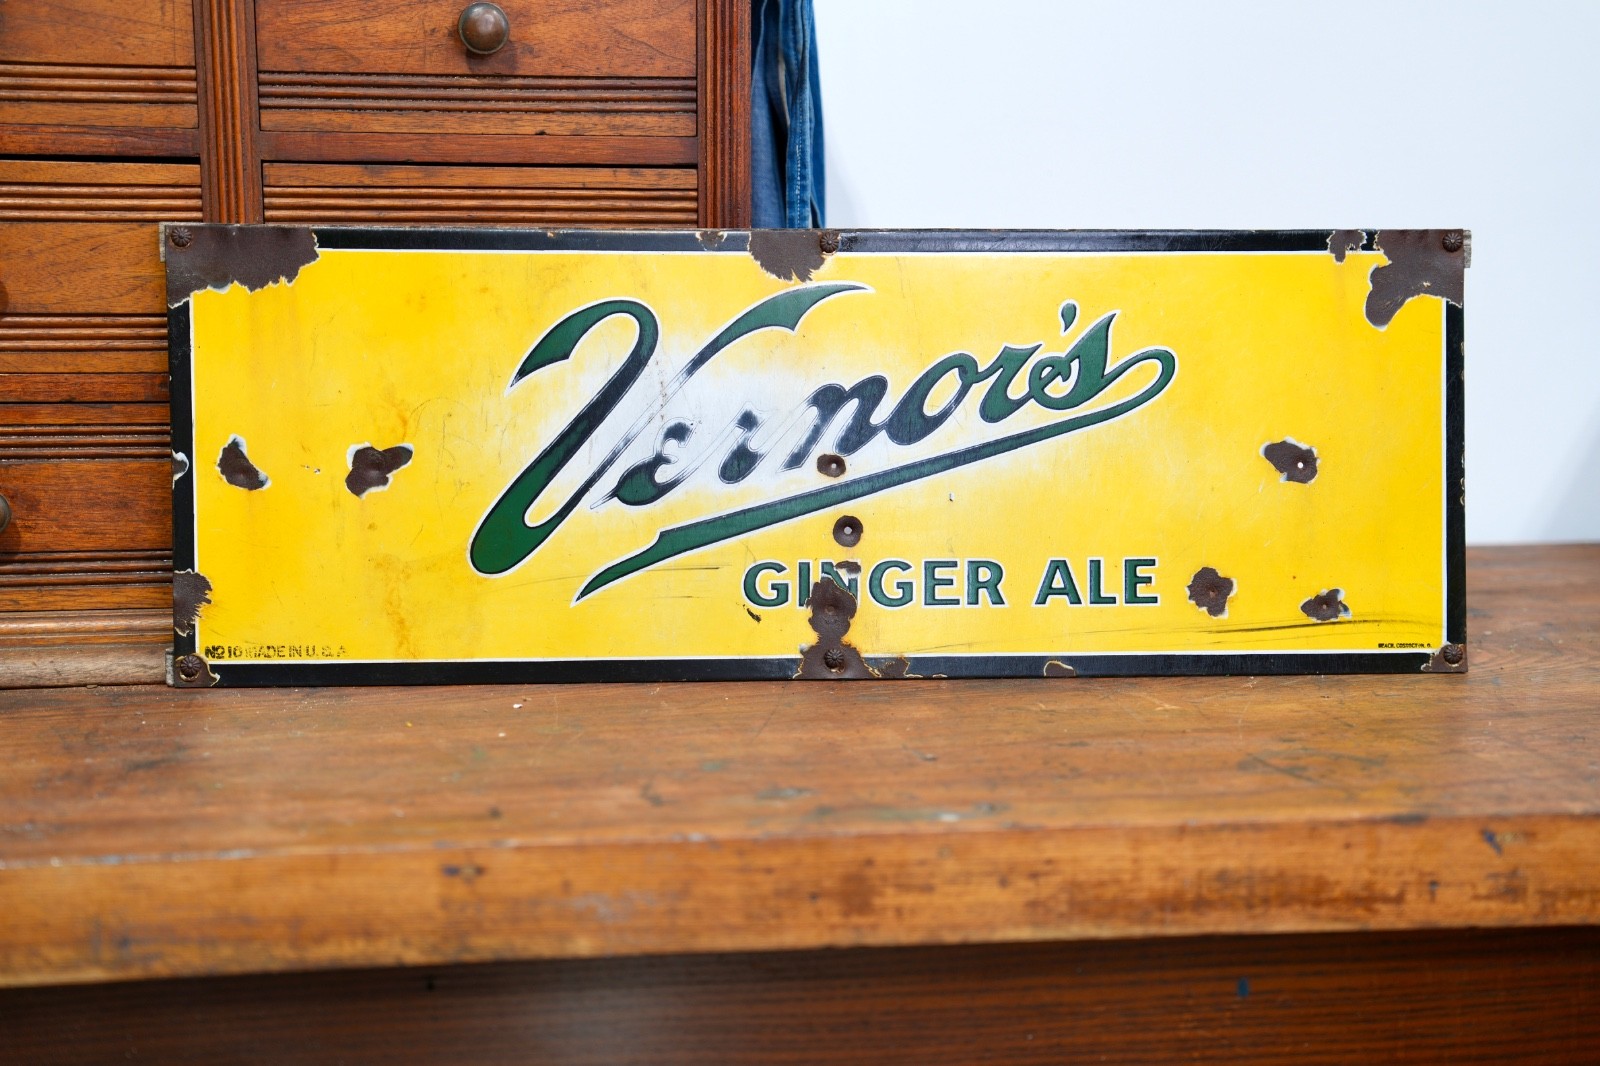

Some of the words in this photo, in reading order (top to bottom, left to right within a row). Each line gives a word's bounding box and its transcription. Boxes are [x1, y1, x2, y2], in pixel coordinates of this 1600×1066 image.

[470, 284, 1176, 580] Vernor's
[1033, 558, 1157, 605] ALE
[289, 646, 302, 658] IN
